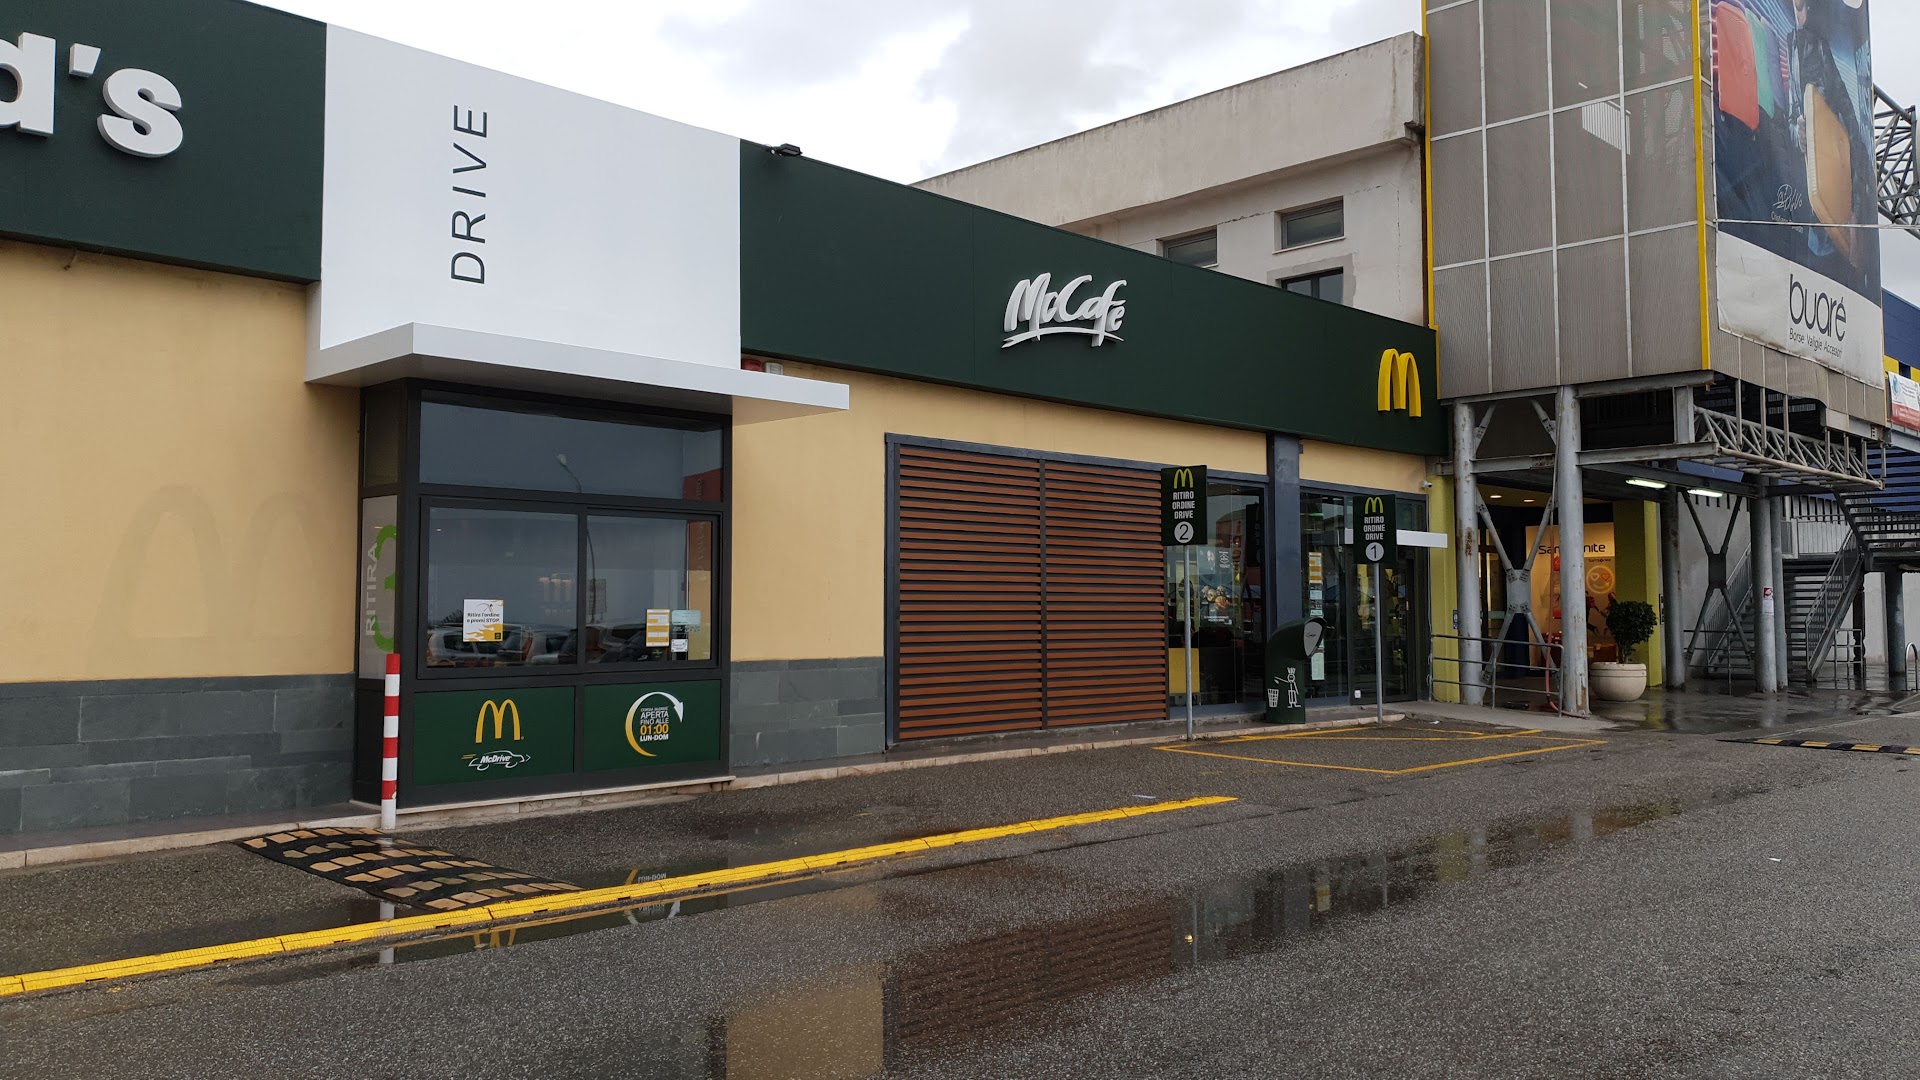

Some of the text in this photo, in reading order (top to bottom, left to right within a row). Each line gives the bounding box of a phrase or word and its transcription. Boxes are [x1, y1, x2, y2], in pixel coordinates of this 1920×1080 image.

[451, 104, 488, 285] DRIVE
[1789, 273, 1847, 342] buaré
[1789, 327, 1805, 344] Borse
[1172, 491, 1195, 500] RITIRO
[1171, 500, 1196, 510] ORDINE
[1174, 510, 1194, 519] DRIVE
[1364, 515, 1385, 524] RITIRO
[1179, 523, 1189, 540] 2
[1363, 524, 1386, 532] ORDINE
[1365, 532, 1384, 540] DRIVE
[1370, 544, 1377, 559] 1
[365, 542, 378, 636] RITIRA
[640, 710, 669, 719] APERTA
[640, 723, 669, 735] 01:00
[640, 733, 669, 742] LUN-DOM
[479, 754, 511, 764] McDrive
